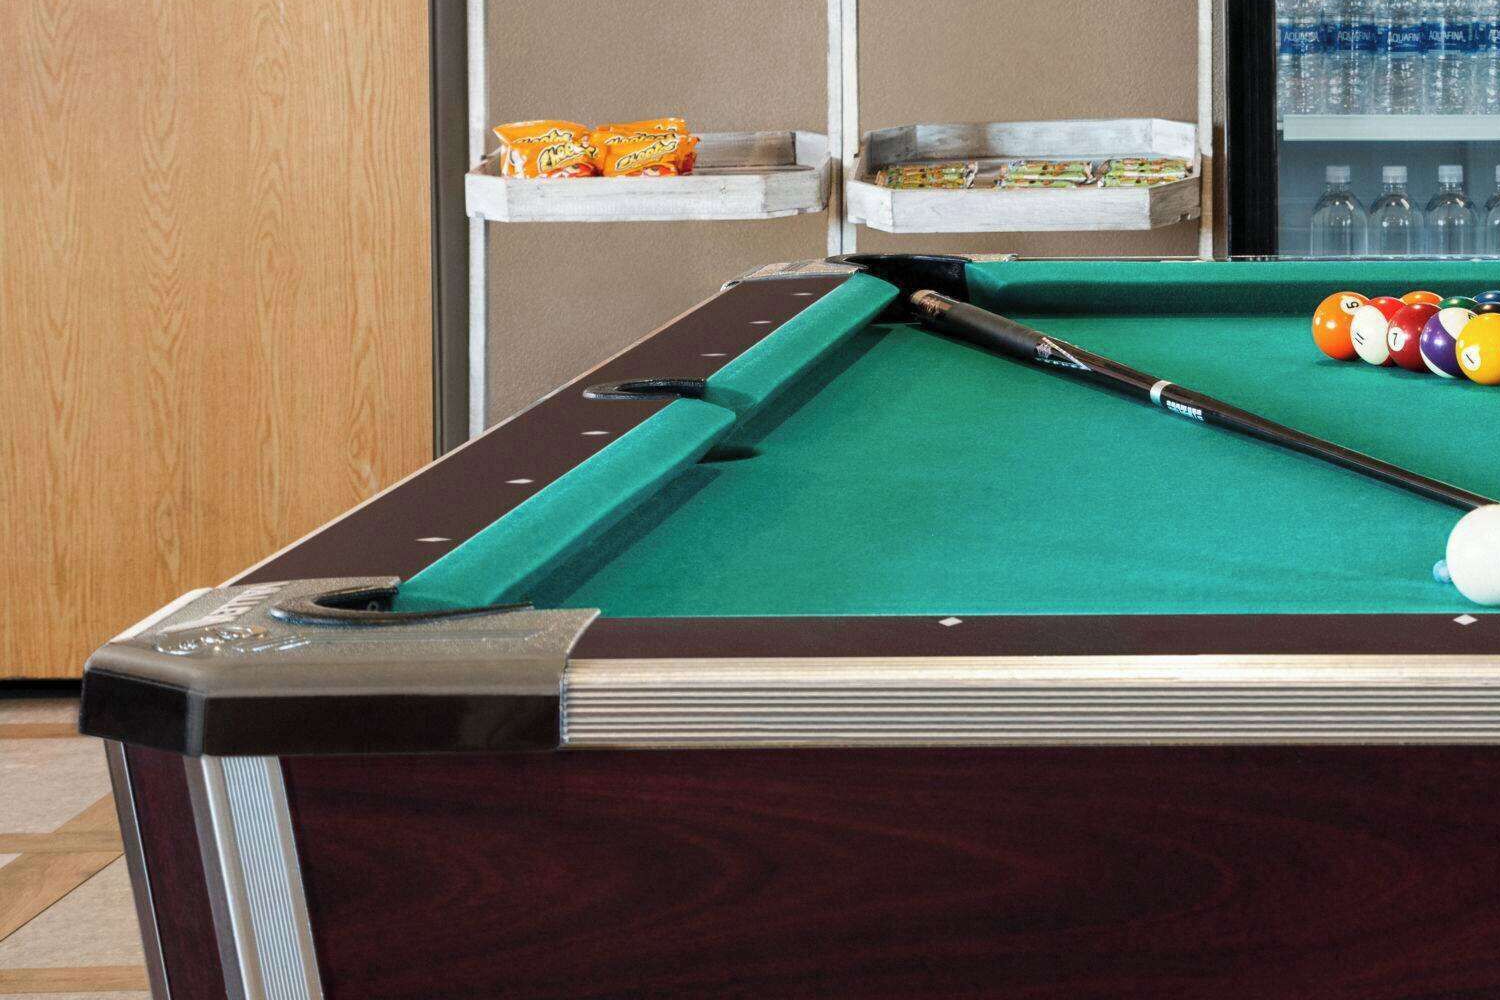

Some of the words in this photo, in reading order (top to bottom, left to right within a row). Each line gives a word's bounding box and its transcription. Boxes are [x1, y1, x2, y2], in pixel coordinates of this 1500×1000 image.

[1354, 332, 1365, 346] 11
[1392, 332, 1399, 346] 7
[1465, 353, 1475, 365] 1
